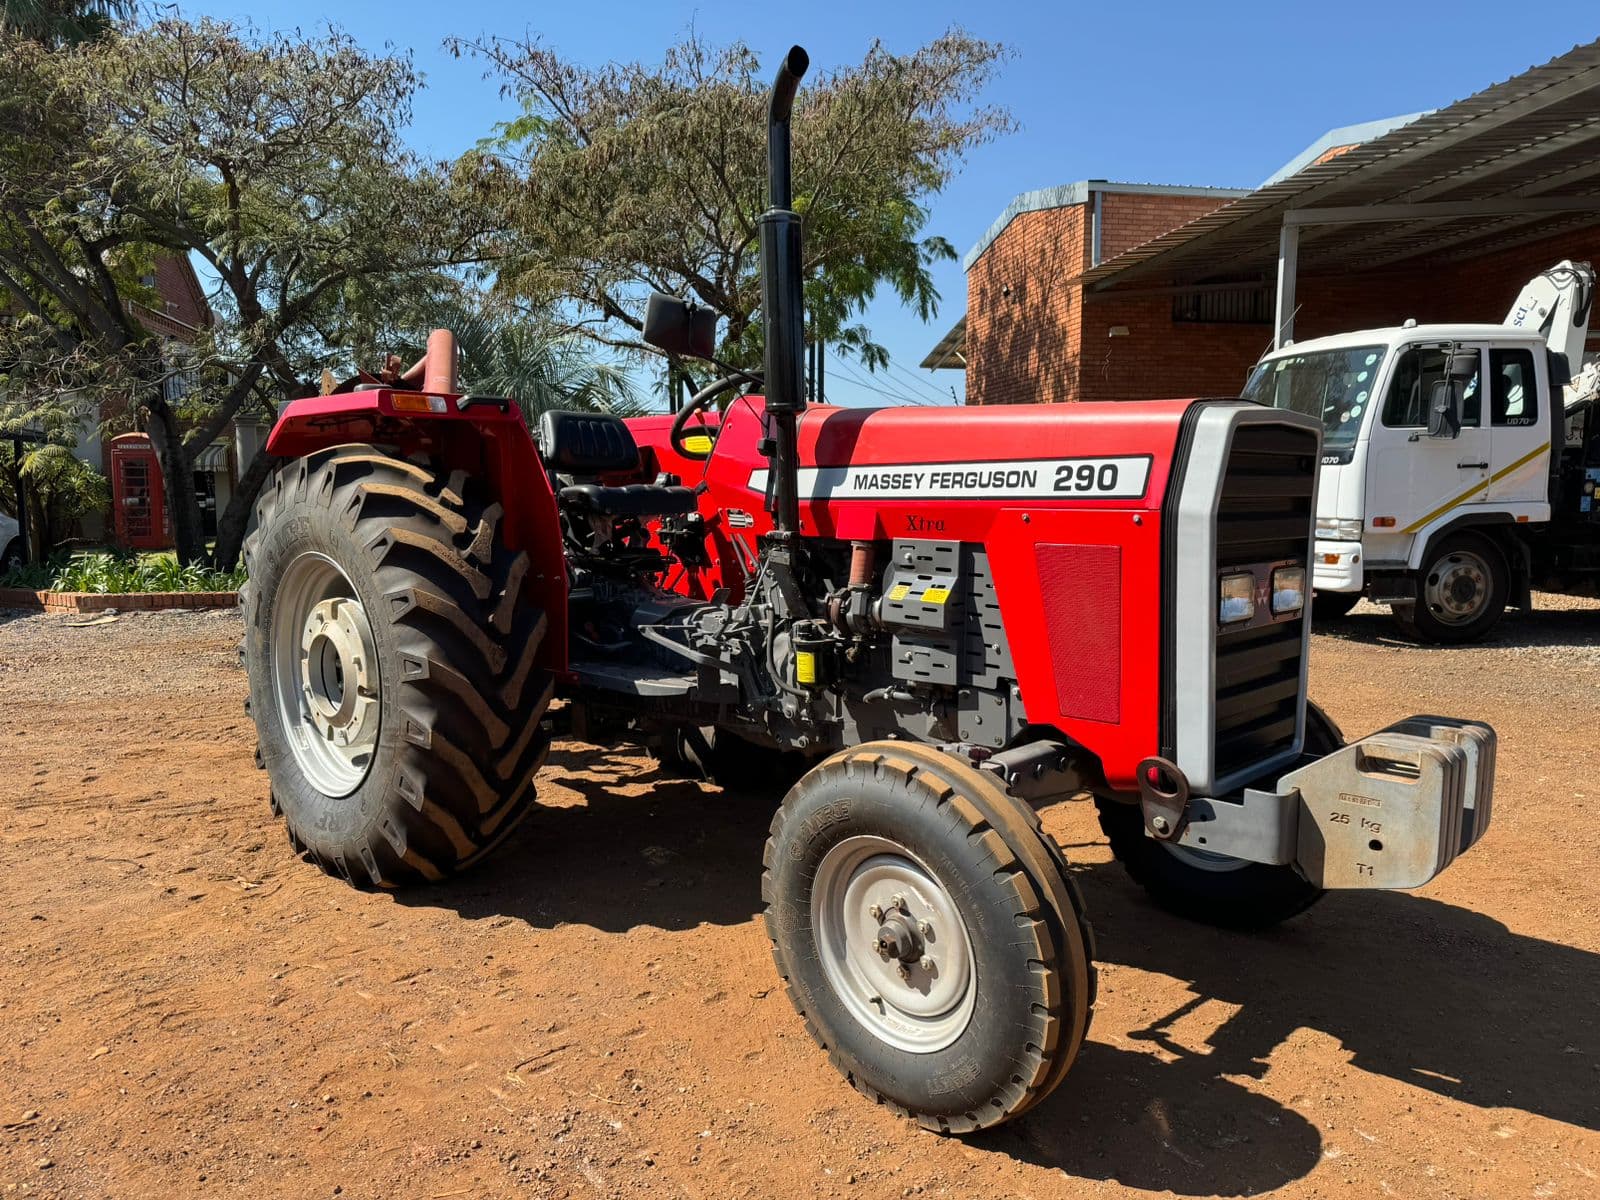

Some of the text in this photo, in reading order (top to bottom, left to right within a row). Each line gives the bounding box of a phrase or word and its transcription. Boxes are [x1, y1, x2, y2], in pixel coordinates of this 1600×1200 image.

[853, 464, 1119, 492] MASSEY FERGUSON 290
[906, 515, 945, 531] Xtra
[1330, 812, 1350, 824] 25
